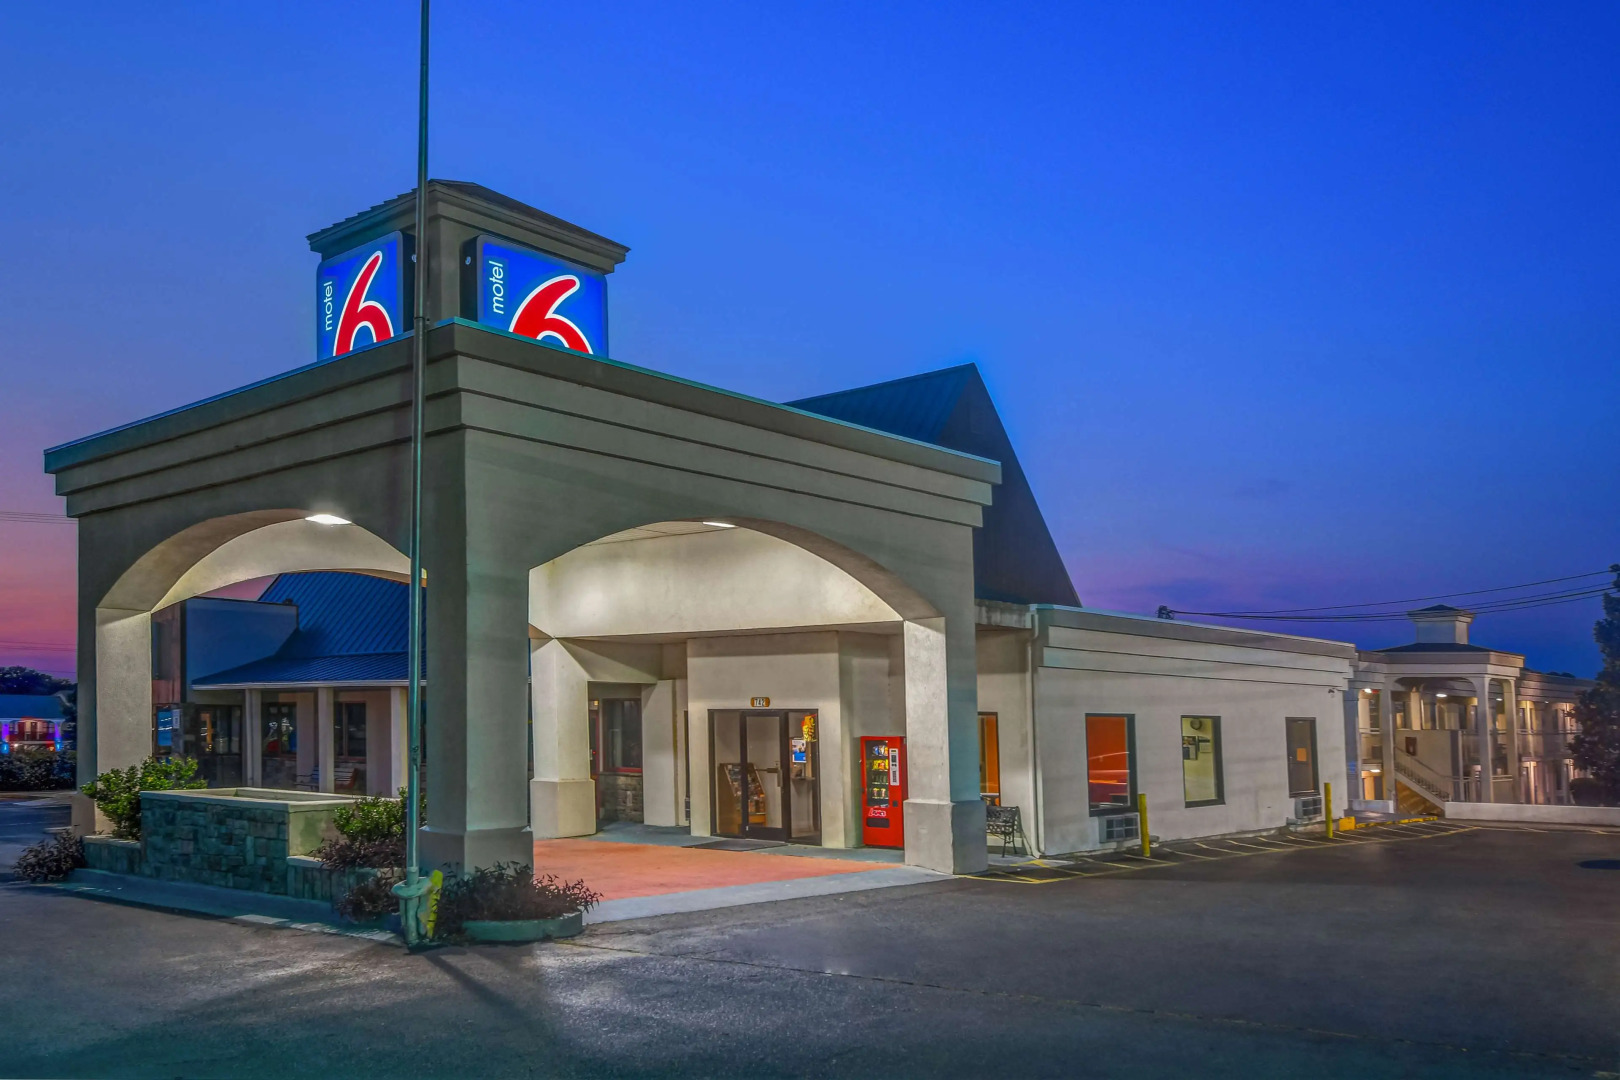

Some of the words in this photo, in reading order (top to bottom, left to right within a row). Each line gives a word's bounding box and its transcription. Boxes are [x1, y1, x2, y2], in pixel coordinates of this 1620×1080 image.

[323, 281, 333, 331] motel
[334, 251, 394, 356] 6
[489, 261, 505, 315] motel
[509, 275, 593, 354] 6
